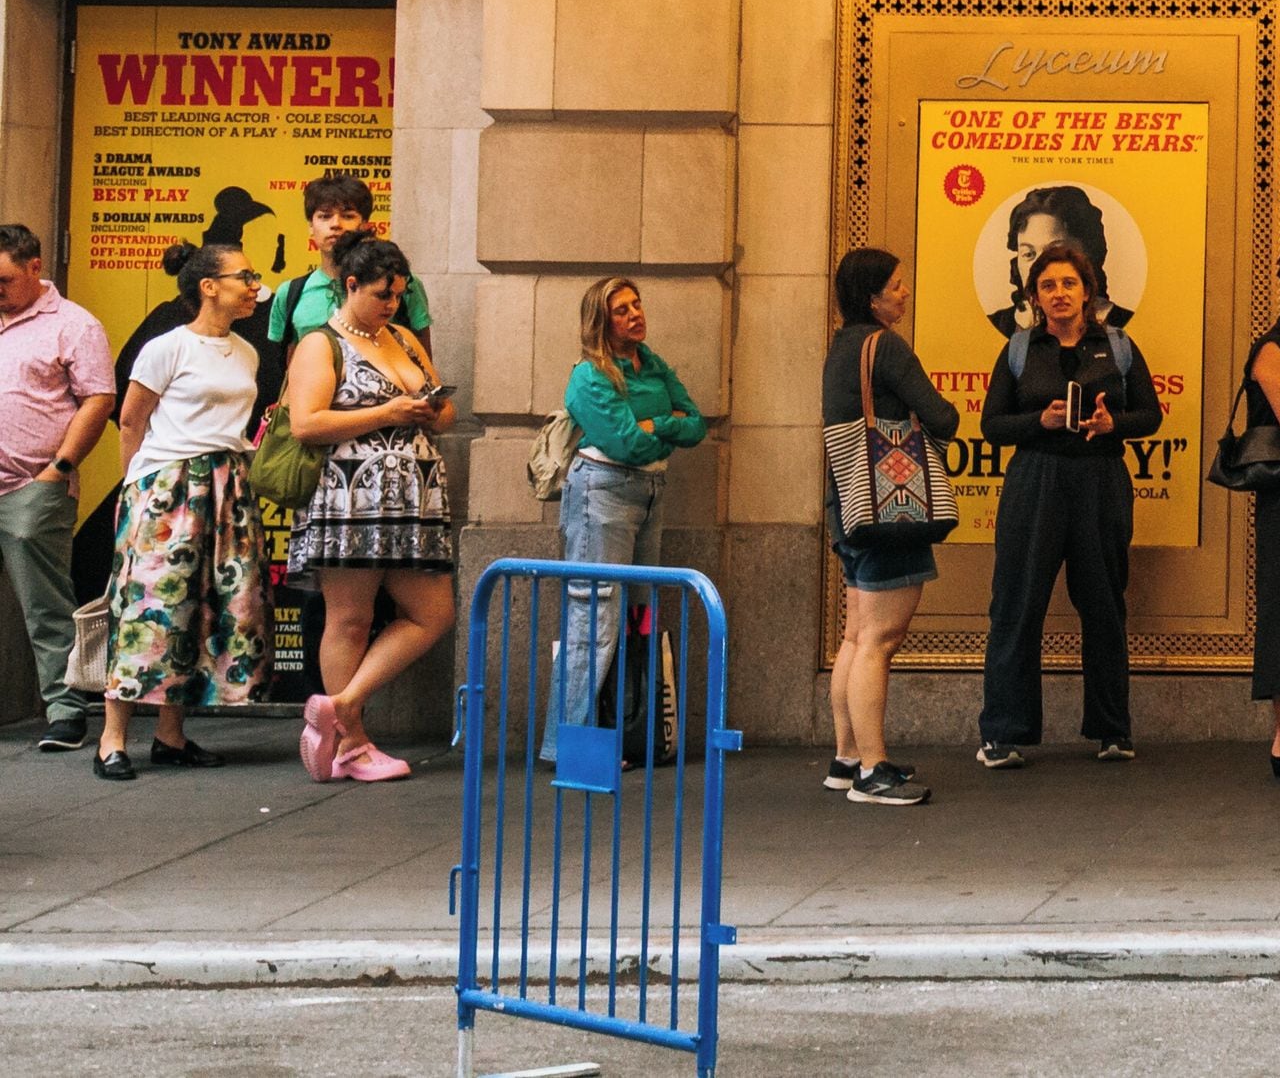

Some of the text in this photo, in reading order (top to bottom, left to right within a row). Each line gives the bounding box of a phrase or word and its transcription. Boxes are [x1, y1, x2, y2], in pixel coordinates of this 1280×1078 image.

[178, 32, 331, 50] TONY AWARD
[955, 42, 1168, 90] Lyceum
[124, 112, 378, 124] BEST LEADING ACTOR COLE ESCOLA
[944, 110, 1182, 130] “ONE OF THE BEST
[94, 126, 392, 139] BEST DIRECTION OF A PLAY SAM PINKLETO
[931, 132, 1064, 151] COMEDIES
[1071, 134, 1102, 151] IN
[94, 153, 152, 163] 3 DRAMA
[304, 155, 391, 165] JOHN GASSNE
[93, 166, 200, 177] LEAGUE AWARDS
[374, 168, 392, 178] FO
[270, 181, 296, 190] NEW
[369, 182, 391, 191] PLA
[93, 188, 189, 201] BEST PLAY
[92, 212, 204, 223] 5 DORIAN AWARDS
[91, 235, 178, 244] OUTSTANDING
[90, 260, 163, 269] PRODUCTIO
[954, 485, 990, 496] NEW
